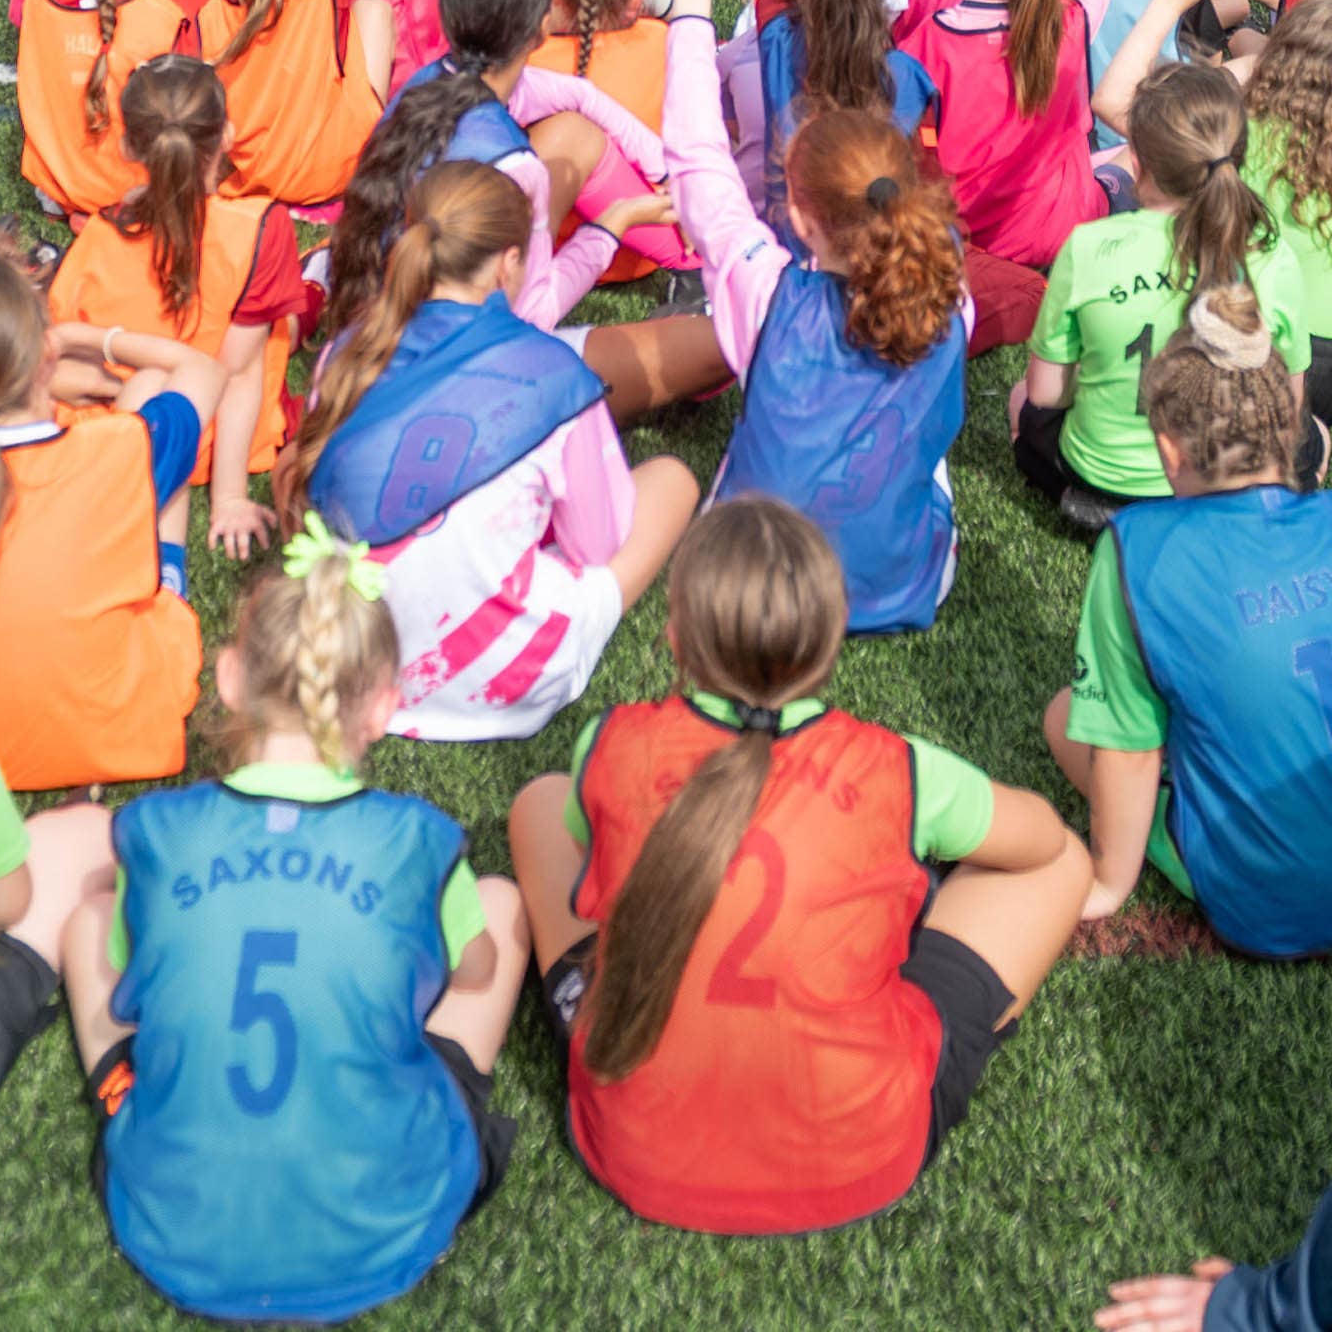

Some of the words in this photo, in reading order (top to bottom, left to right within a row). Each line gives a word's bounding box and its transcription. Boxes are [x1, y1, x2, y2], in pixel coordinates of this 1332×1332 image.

[375, 412, 477, 536] 8
[171, 847, 383, 916] SAXONS
[705, 825, 787, 1009] 2
[226, 930, 298, 1118] 5
